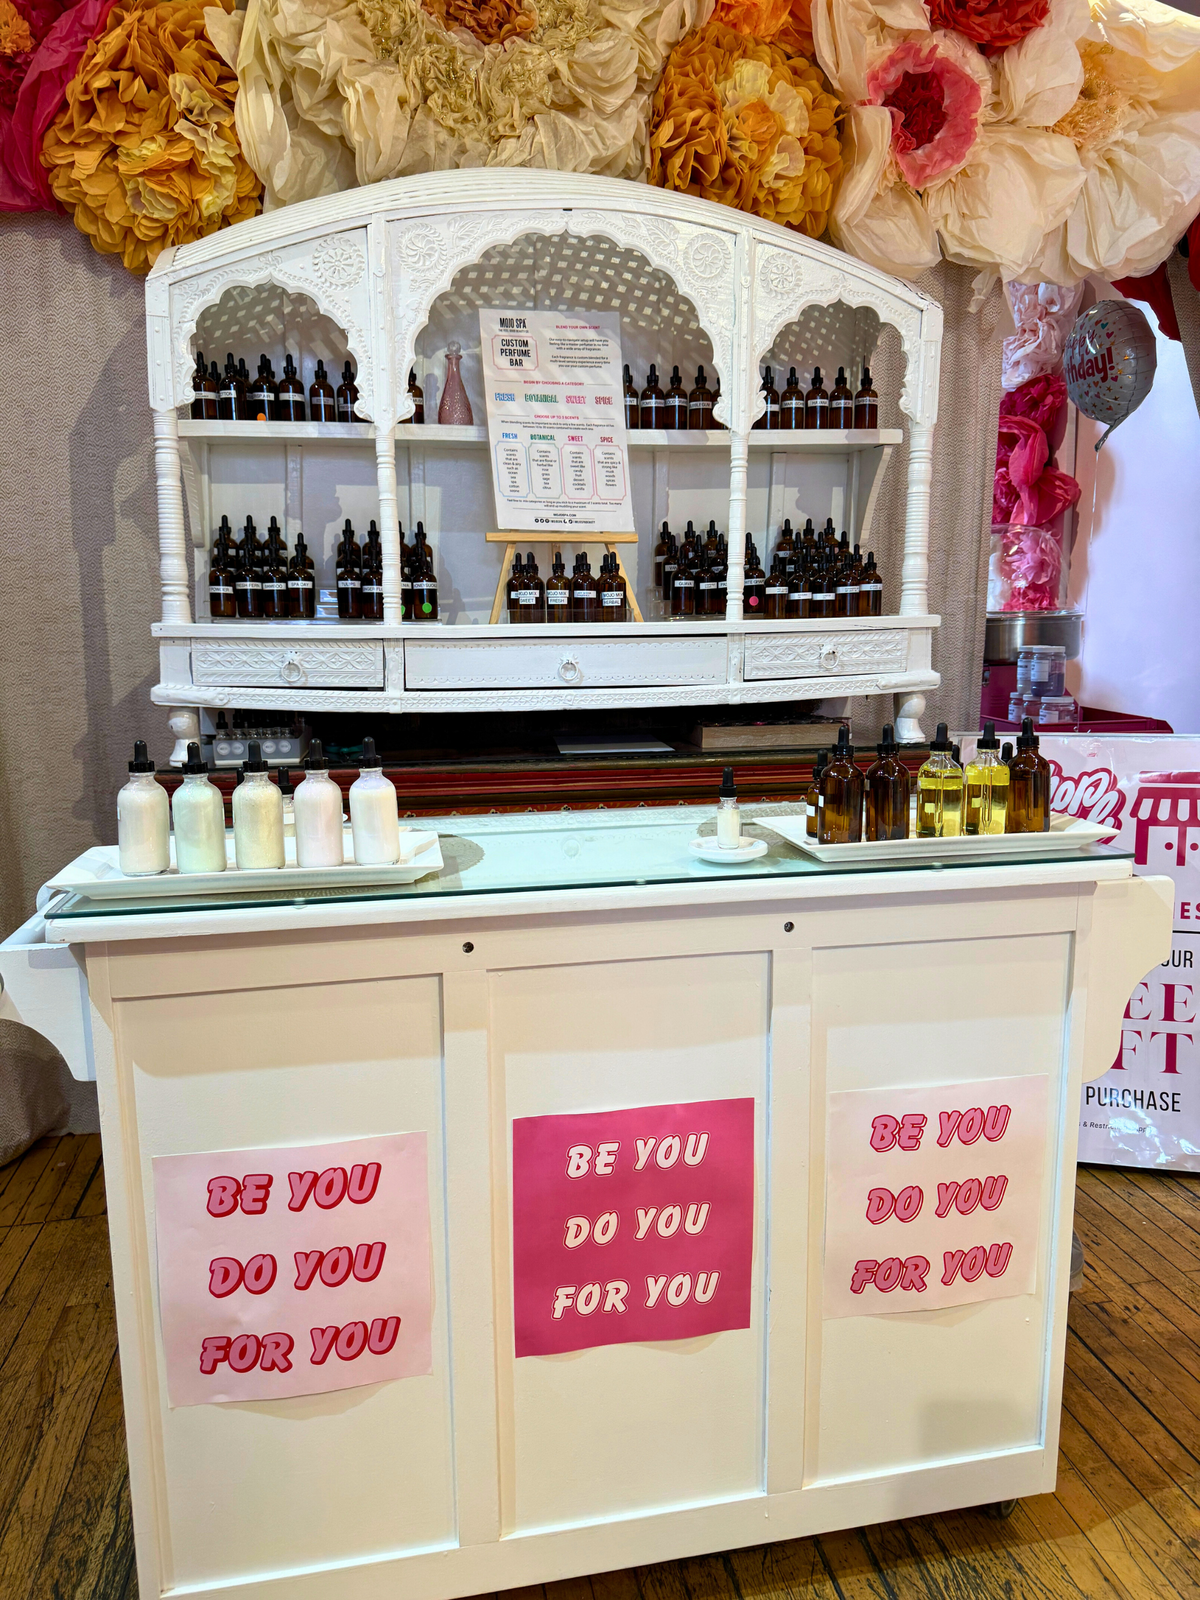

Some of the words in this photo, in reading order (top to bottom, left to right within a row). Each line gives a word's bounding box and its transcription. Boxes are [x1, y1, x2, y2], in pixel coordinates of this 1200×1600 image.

[500, 318, 514, 328] MOJO
[516, 318, 526, 329] SPA
[501, 339, 529, 348] CUSTOM
[500, 348, 531, 357] PERFUME
[510, 358, 524, 367] BAR
[1086, 1086, 1181, 1112] PURCHASE
[870, 1114, 928, 1152] BE
[937, 1104, 1012, 1148] YOU
[566, 1140, 621, 1180] BE
[634, 1132, 711, 1172] YOU
[207, 1174, 273, 1218] BE
[288, 1162, 382, 1212] YOU
[866, 1186, 924, 1225] DO
[935, 1175, 1008, 1218] YOU
[563, 1210, 620, 1250] DO
[634, 1202, 711, 1240] YOU
[209, 1254, 277, 1298] DO
[294, 1242, 386, 1290] YOU
[850, 1255, 930, 1294] FOR
[941, 1242, 1013, 1286] YOU
[552, 1279, 629, 1320] FOR
[645, 1271, 720, 1309] YOU
[200, 1332, 294, 1374] FOR
[310, 1316, 401, 1365] YOU
